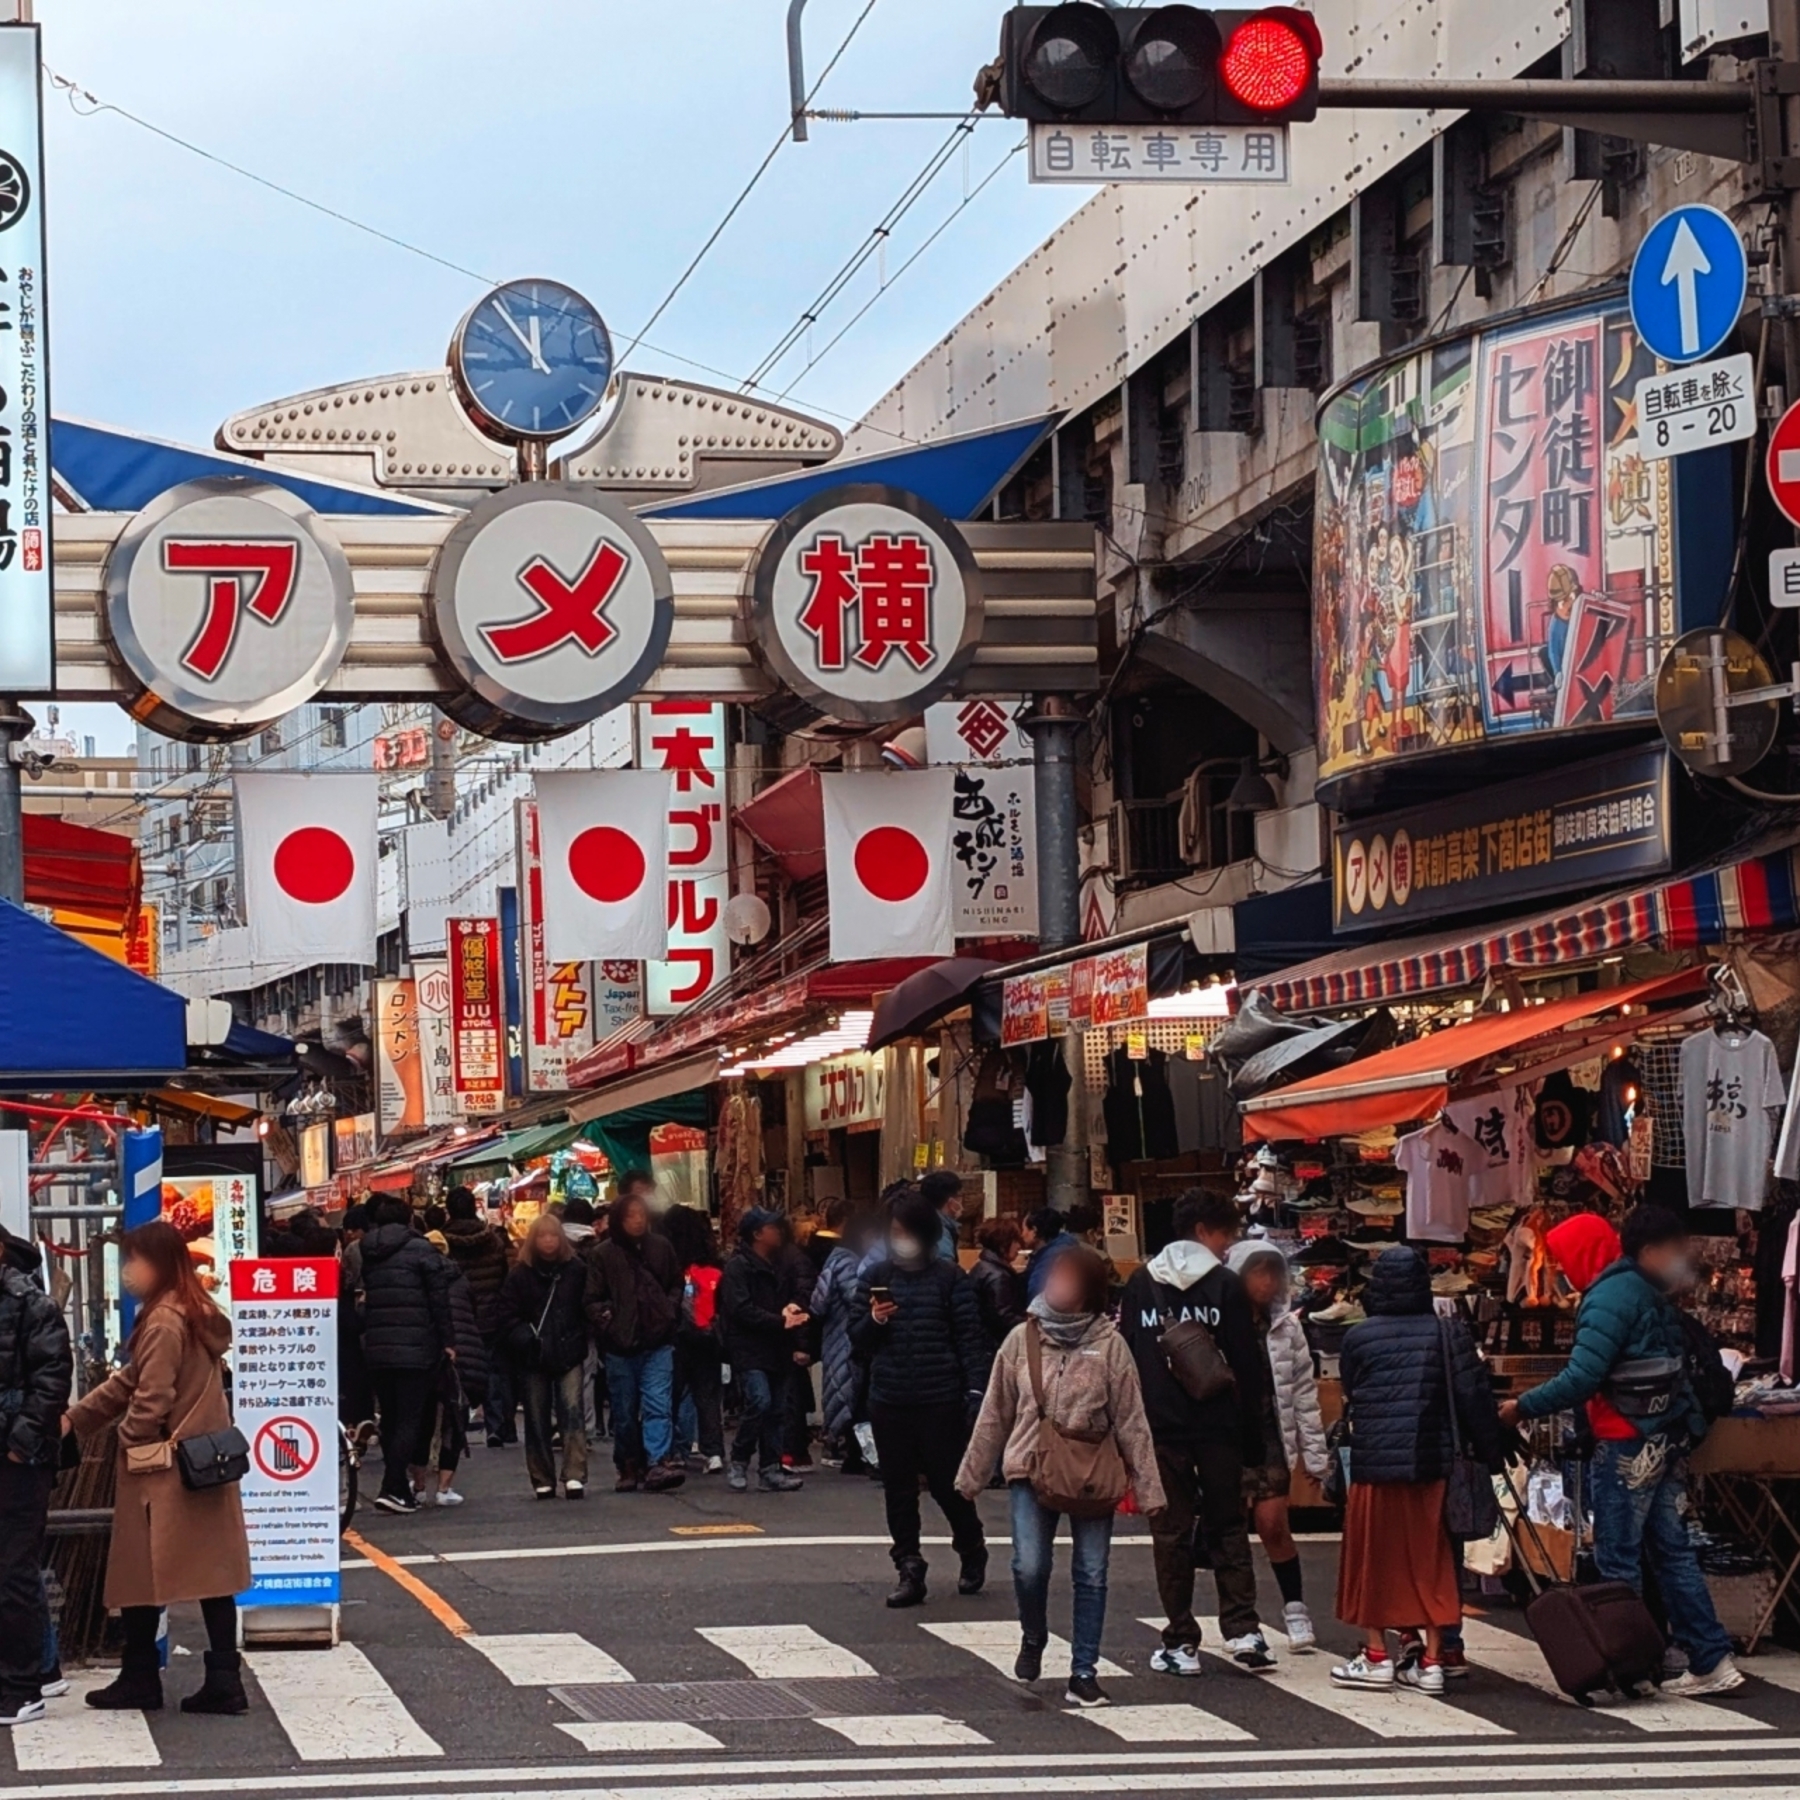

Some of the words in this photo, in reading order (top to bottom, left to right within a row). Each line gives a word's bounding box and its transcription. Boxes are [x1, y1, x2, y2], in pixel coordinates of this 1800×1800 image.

[1046, 131, 1276, 172] 自転車専用
[1645, 370, 1743, 416] 自転車を除く
[1541, 337, 1594, 557] 御徒町
[1489, 353, 1537, 644] センター
[1350, 843, 1409, 897] アメ横
[1414, 809, 1551, 890] 駅前高架下商店街
[963, 907, 1025, 915] NISHINARI
[979, 916, 1009, 924] KING
[602, 1003, 638, 1013] Tax-fre
[462, 1020, 493, 1028] STORE
[431, 1018, 451, 1096] 小島屋
[252, 1267, 317, 1293] 危険
[239, 1344, 316, 1355] 事故やトラブルの
[239, 1361, 326, 1372] 原因となりますので
[254, 1576, 333, 1589] メ横商店街連合会
